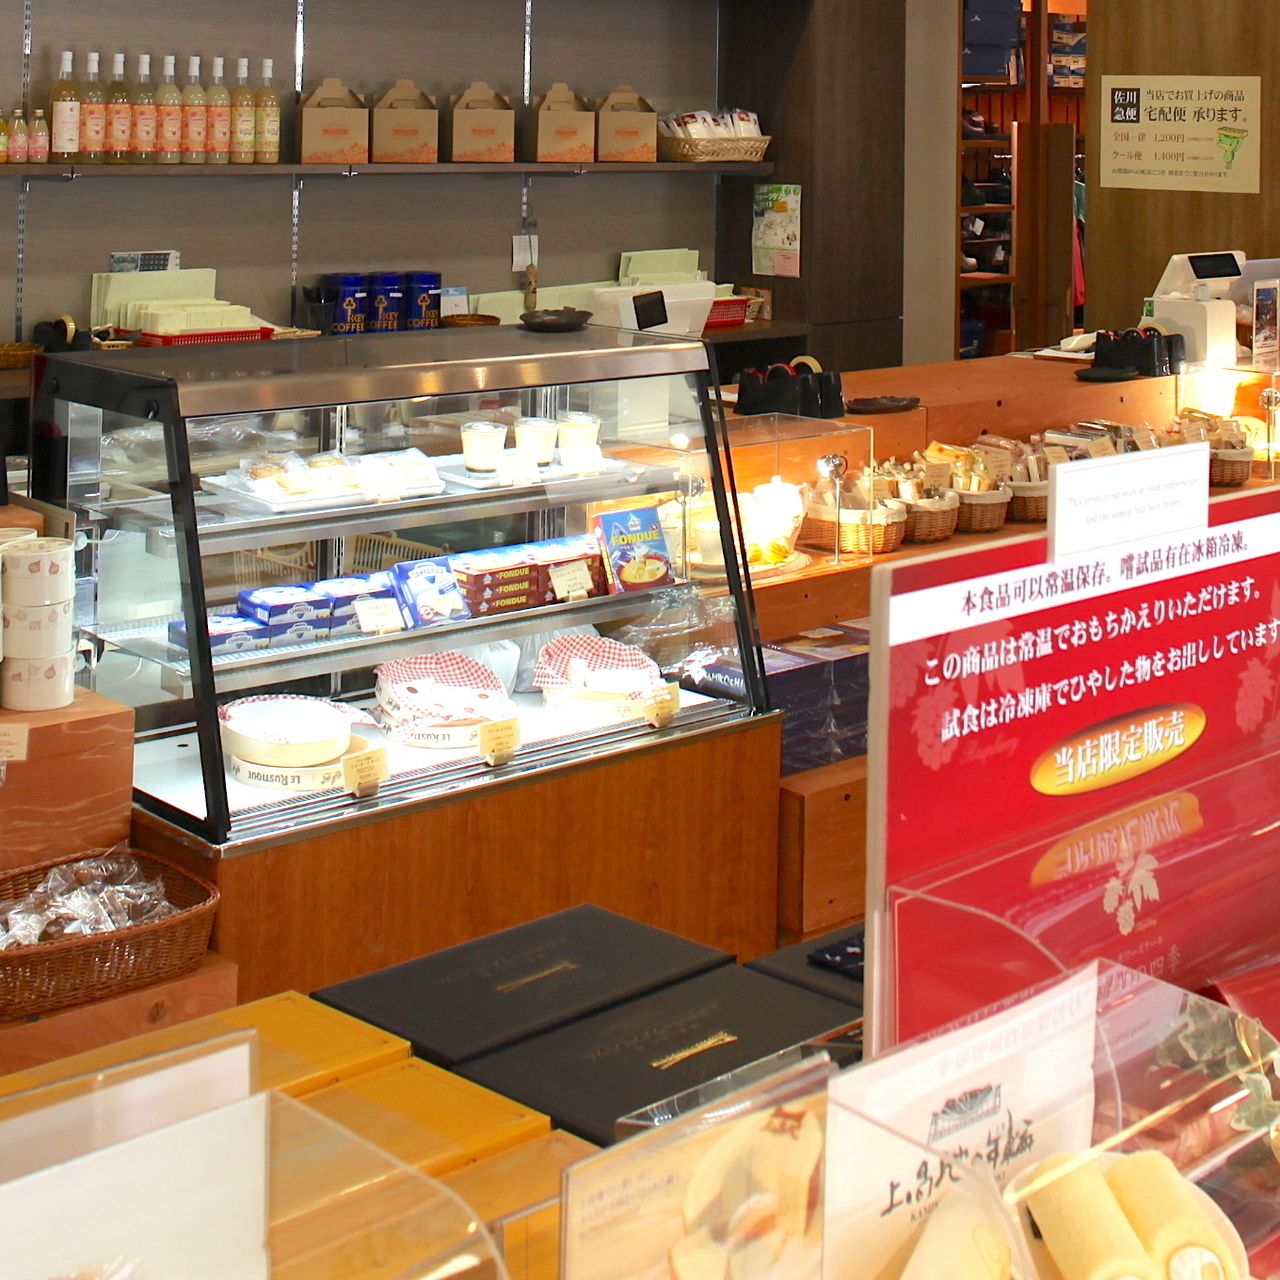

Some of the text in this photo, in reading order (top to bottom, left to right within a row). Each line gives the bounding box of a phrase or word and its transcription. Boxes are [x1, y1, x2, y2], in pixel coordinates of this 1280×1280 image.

[1114, 90, 1137, 104] 佐川
[1113, 106, 1247, 123] 急便 宅配便 承ります。
[350, 313, 365, 322] KEY
[383, 311, 399, 320] KEY
[424, 309, 439, 318] KEY
[332, 322, 365, 332] COFFEE
[407, 318, 439, 327] COFFEE
[610, 529, 660, 546] FONDUE
[498, 568, 530, 580] FONDUE
[498, 581, 530, 594] FONDUE
[496, 595, 528, 608] FONDUE
[922, 575, 1261, 688] この商品は常温でおもちかえりいただけます。
[1052, 709, 1187, 789] 当店限定販売
[247, 770, 289, 786] RUSTIQUE
